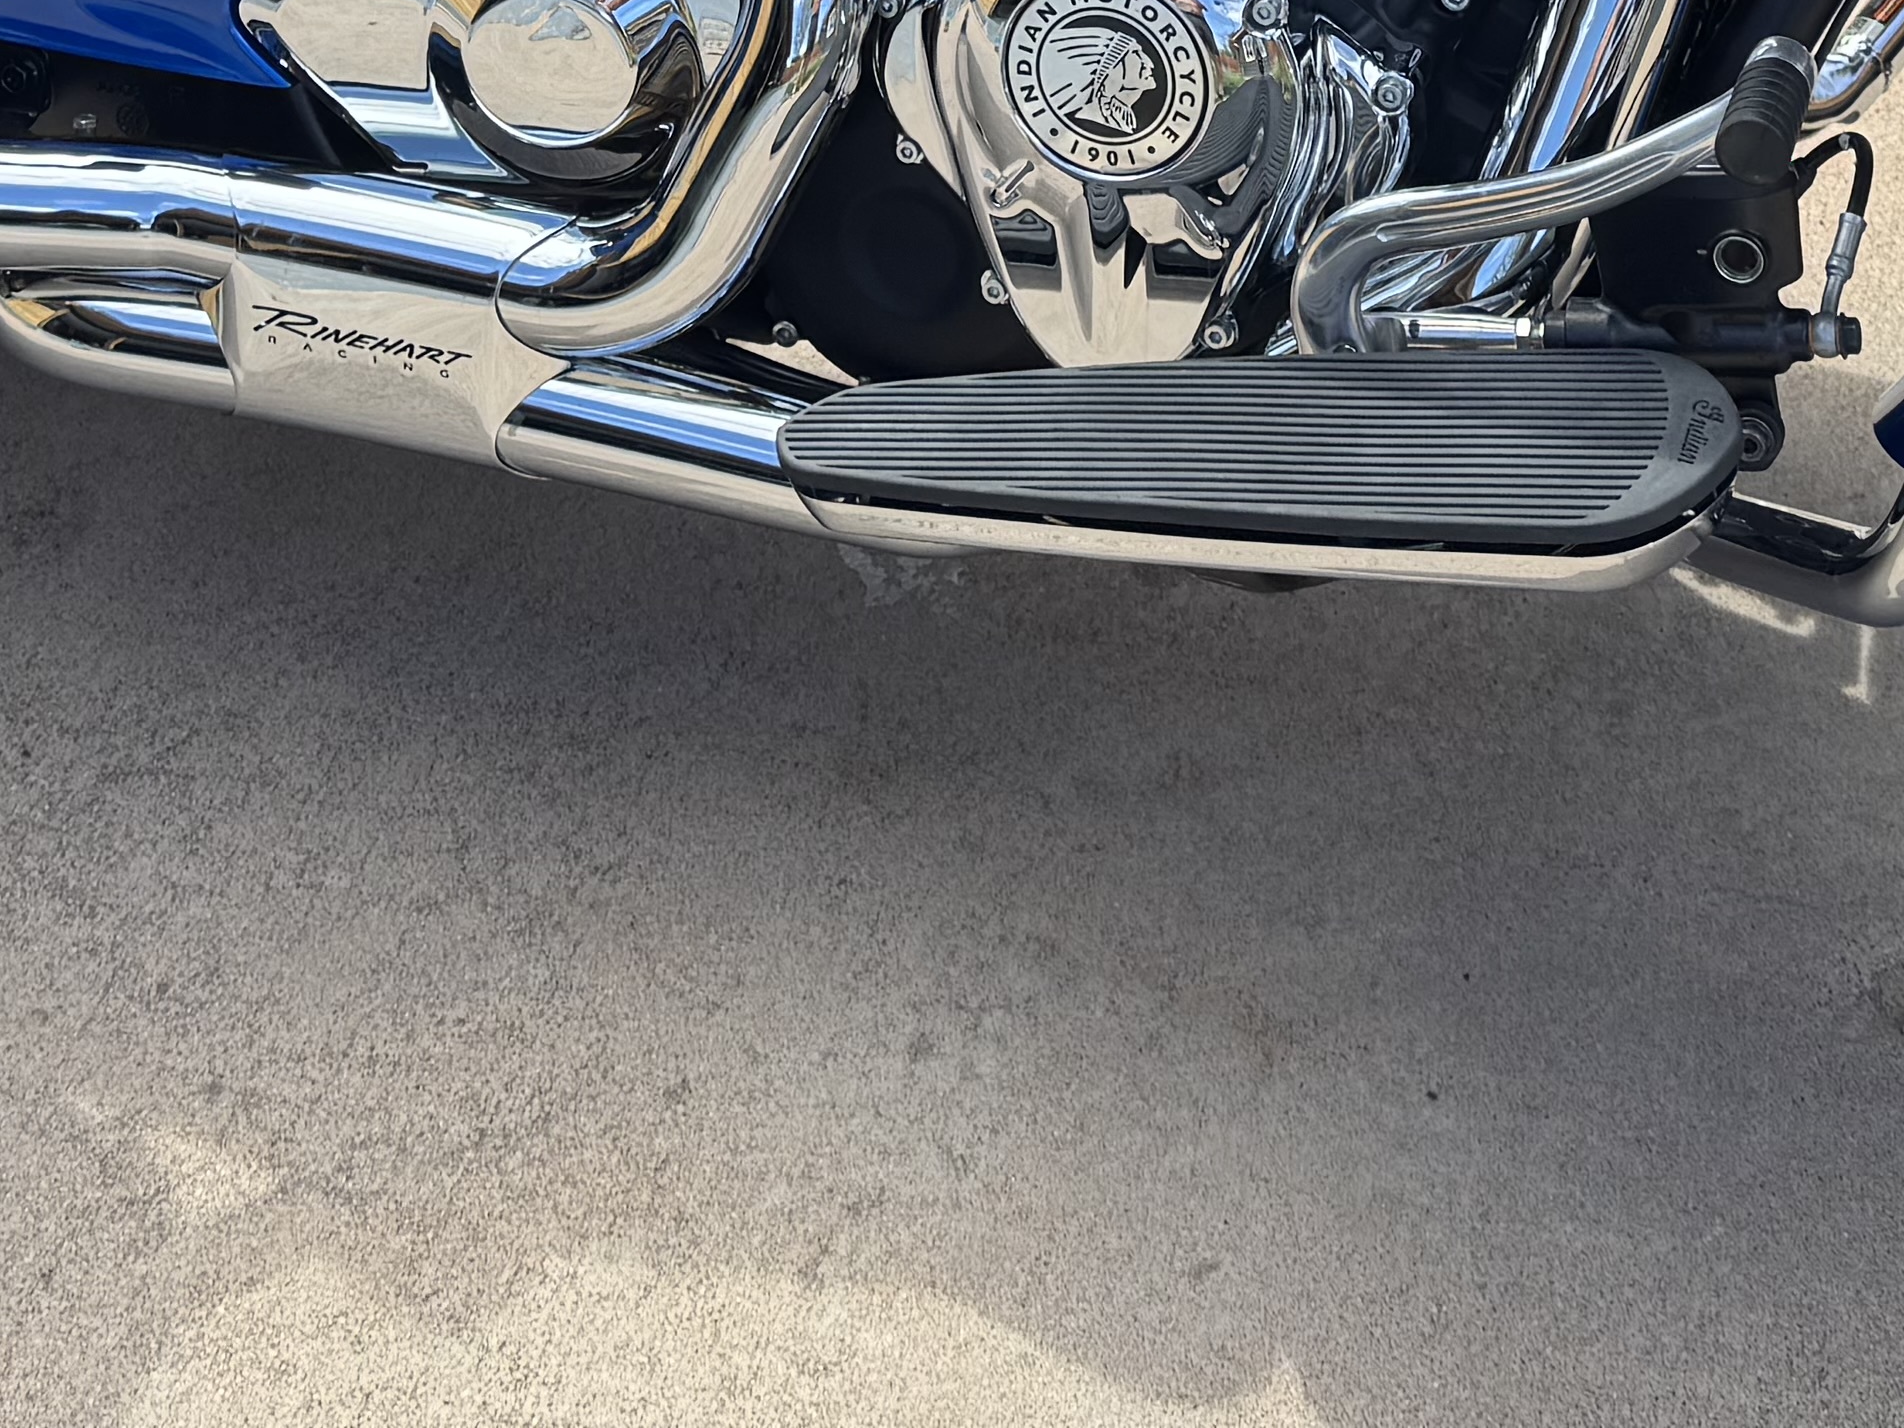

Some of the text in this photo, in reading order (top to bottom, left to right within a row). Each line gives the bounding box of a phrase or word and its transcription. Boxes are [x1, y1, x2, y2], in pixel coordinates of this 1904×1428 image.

[1016, 1, 1058, 119] INDIAN
[1070, 139, 1137, 167] 1901
[252, 304, 473, 366] RINEHART
[1676, 399, 1726, 465] Indian
